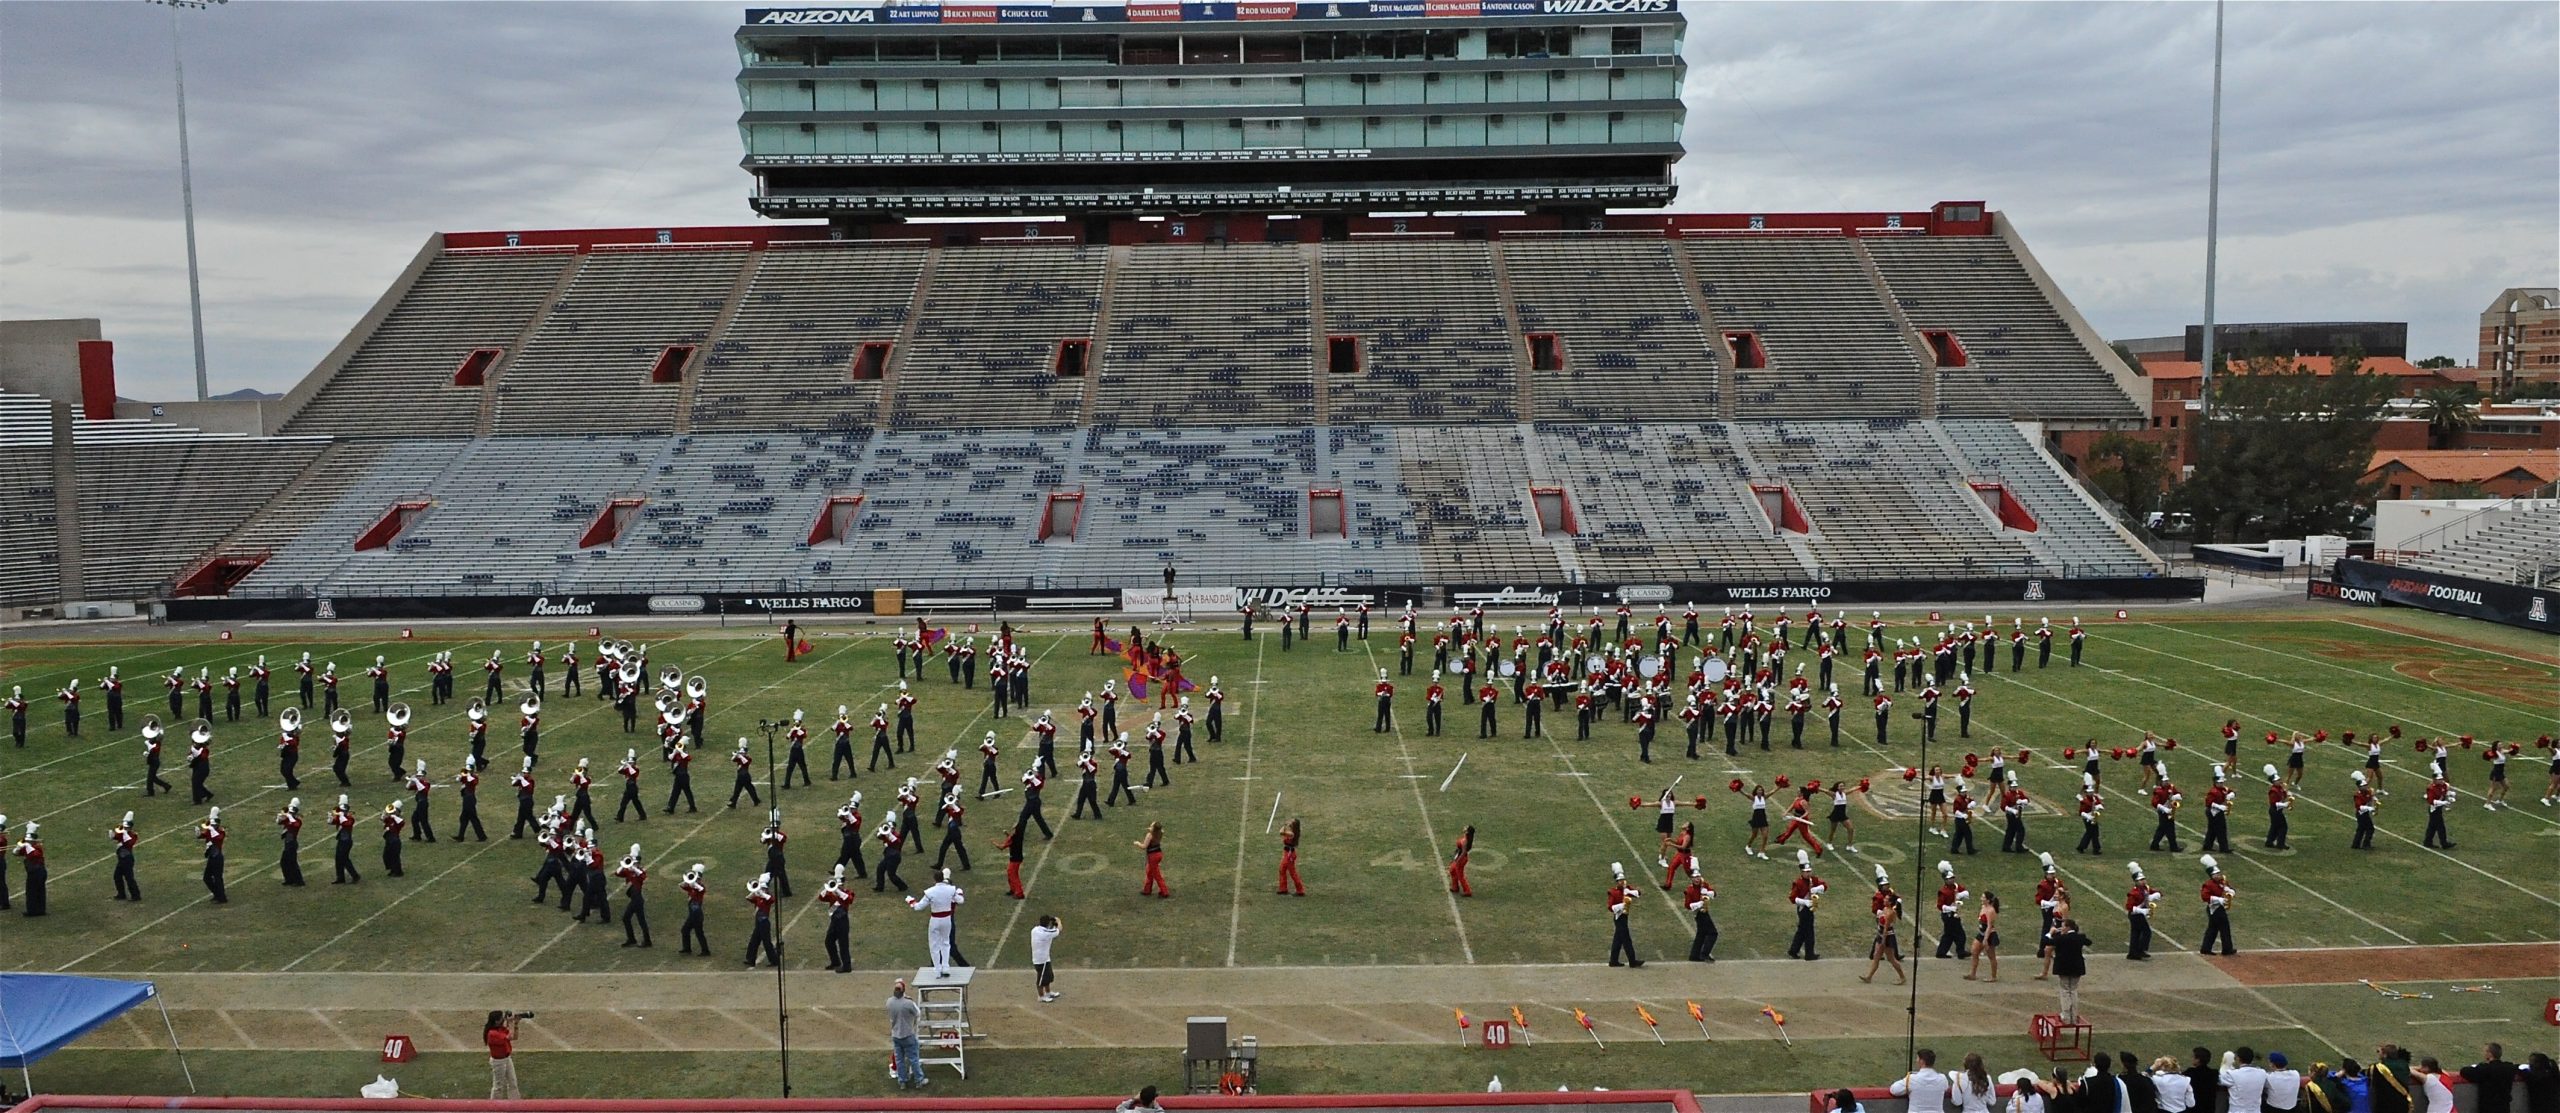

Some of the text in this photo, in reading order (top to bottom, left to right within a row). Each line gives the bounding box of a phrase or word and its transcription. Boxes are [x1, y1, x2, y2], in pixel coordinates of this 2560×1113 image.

[1393, 4, 1425, 12] McLAUGHLIN
[1450, 3, 1480, 11] McALISTER
[1487, 2, 1512, 10] ANTOINE
[1513, 2, 1535, 10] CASON
[1543, 0, 1668, 13] WILDCATS
[759, 10, 875, 24] ARIZONA
[890, 10, 898, 18] 22
[912, 10, 939, 18] LUPPINO
[1002, 9, 1048, 18] 6 CHUCK CECIL
[1127, 9, 1132, 17] 4
[1132, 9, 1160, 17] DARRYLL
[1394, 223, 1407, 232] 22
[1590, 221, 1603, 230] 23
[1750, 220, 1763, 229] 24
[1888, 220, 1900, 229] 25
[1025, 228, 1038, 237] 20
[1172, 226, 1184, 235] 21
[658, 234, 670, 243] 18
[831, 232, 842, 240] 19
[508, 238, 518, 246] 17
[153, 406, 163, 415] 16
[1727, 587, 1831, 598] WELLS FARGO
[2024, 580, 2045, 600] A
[2312, 583, 2376, 603] BEAR DOWN
[2427, 584, 2482, 605] FOOTBALL
[758, 598, 861, 609] WELLS FARGO
[1125, 595, 1159, 605] UNIVERSITY
[1200, 595, 1219, 604] BAND
[1220, 595, 1233, 604] DAY
[316, 599, 336, 618] A
[531, 597, 596, 615] Bashas'
[2528, 597, 2547, 622] A
[1487, 1025, 1505, 1044] 40
[384, 1039, 403, 1060] 40
